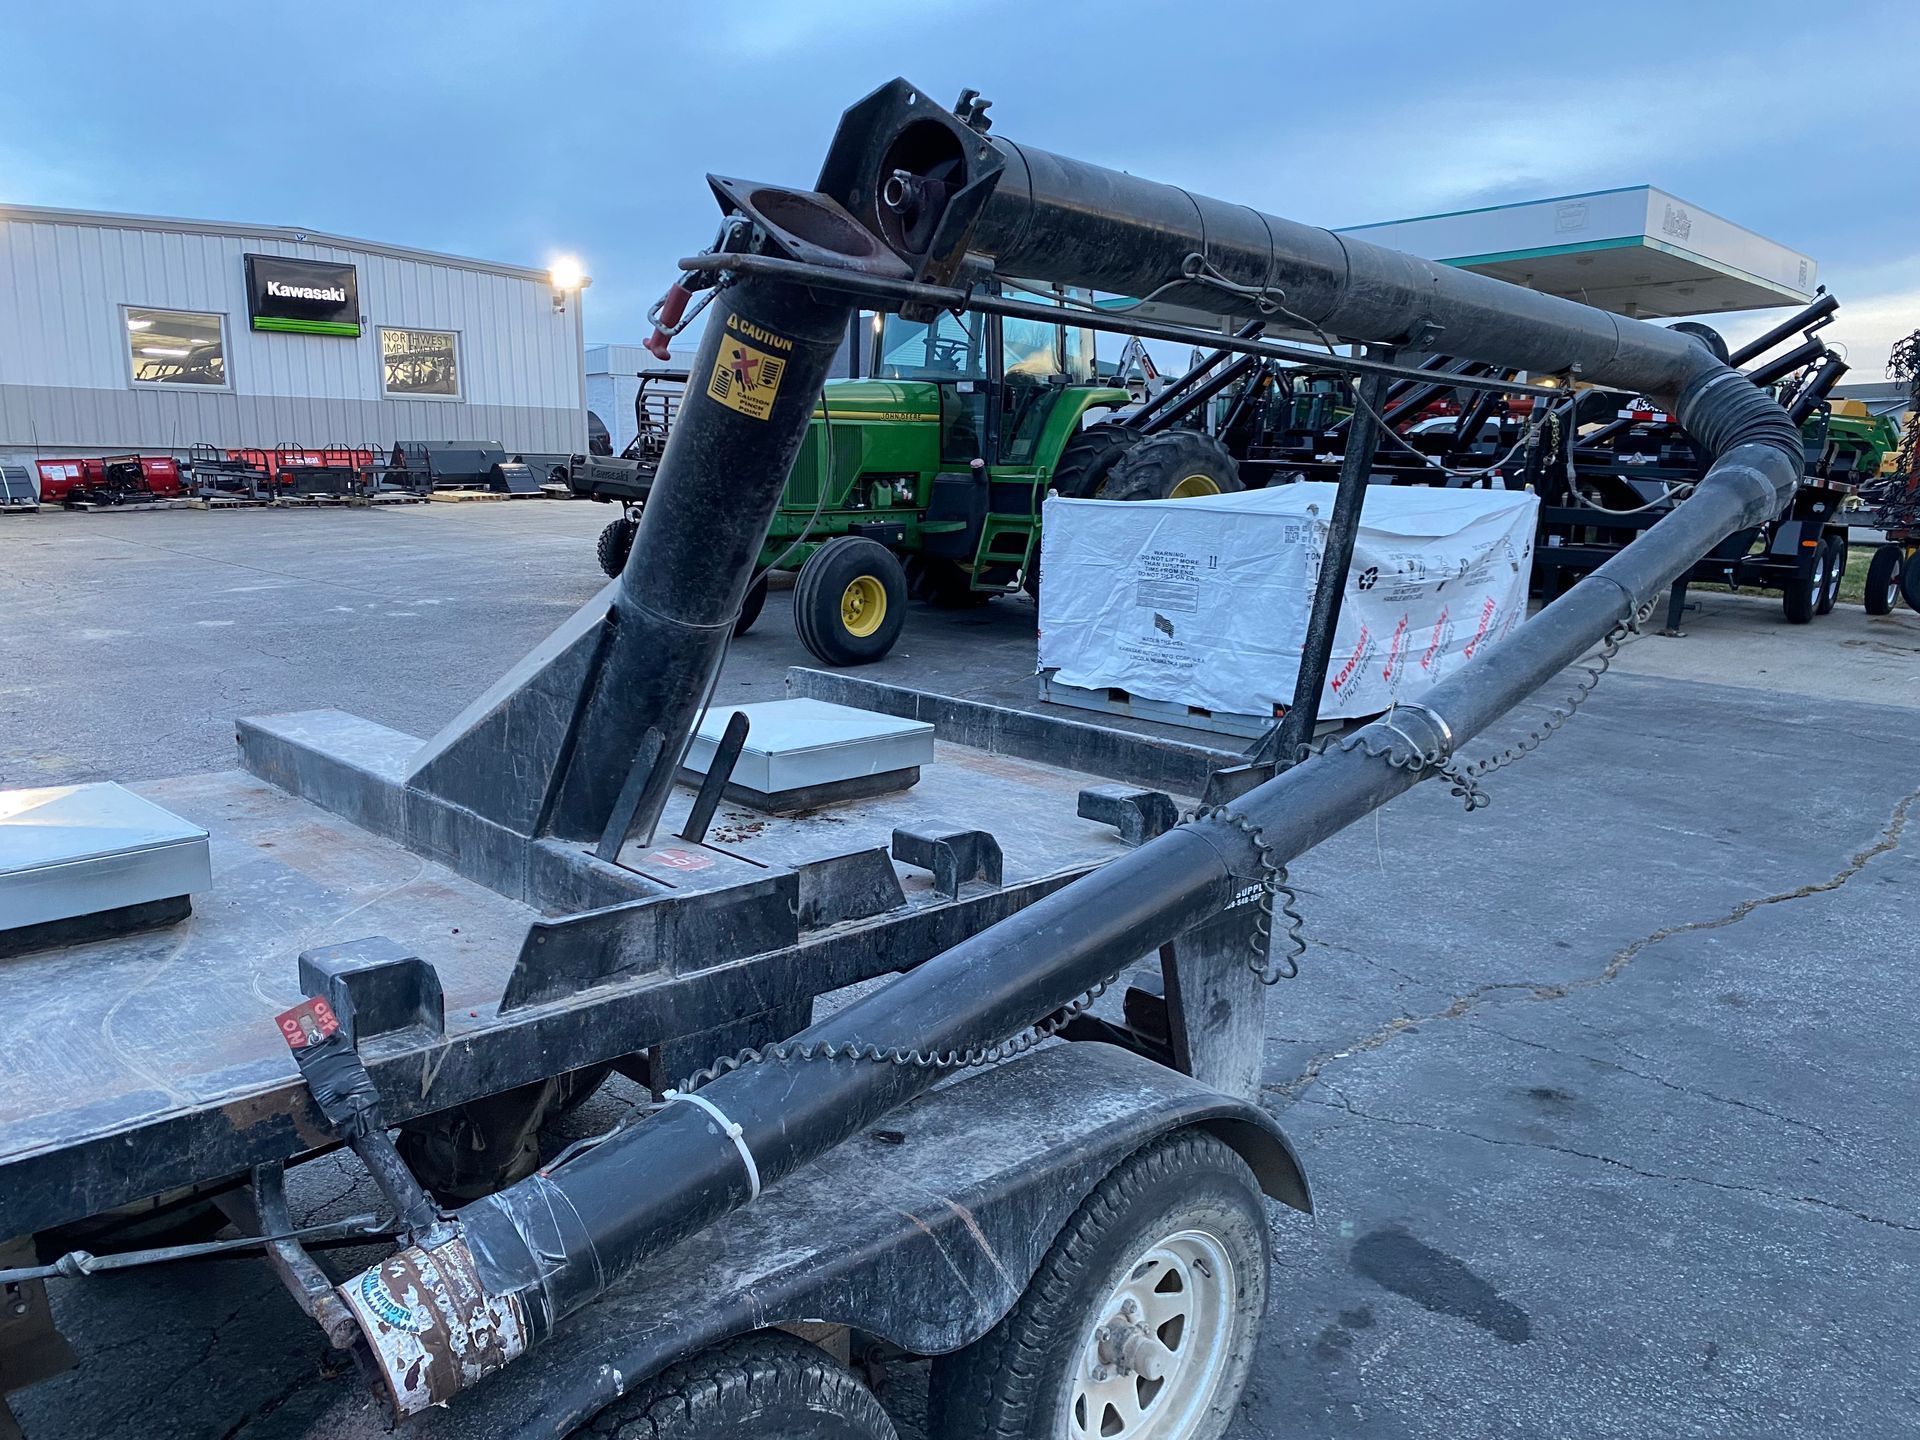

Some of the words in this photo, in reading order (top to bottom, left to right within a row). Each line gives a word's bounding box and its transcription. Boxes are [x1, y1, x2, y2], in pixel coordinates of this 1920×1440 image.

[266, 281, 346, 302] Kawasaki
[384, 332, 449, 347] NORTHWEST
[740, 319, 793, 351] CAUTION
[384, 343, 442, 355] IMPLEMENT
[736, 391, 770, 407] CAUTION
[739, 400, 764, 412] PINCH
[738, 406, 762, 417] POINT
[880, 412, 900, 422] JOHN
[900, 412, 922, 422] DEERE
[591, 466, 629, 482] Kawasaki
[1464, 595, 1496, 660] Kawasaki
[1331, 618, 1369, 693] Kawasaki
[314, 1002, 339, 1031] OFF
[283, 1019, 305, 1045] ON
[373, 1289, 412, 1322] REGULAR
